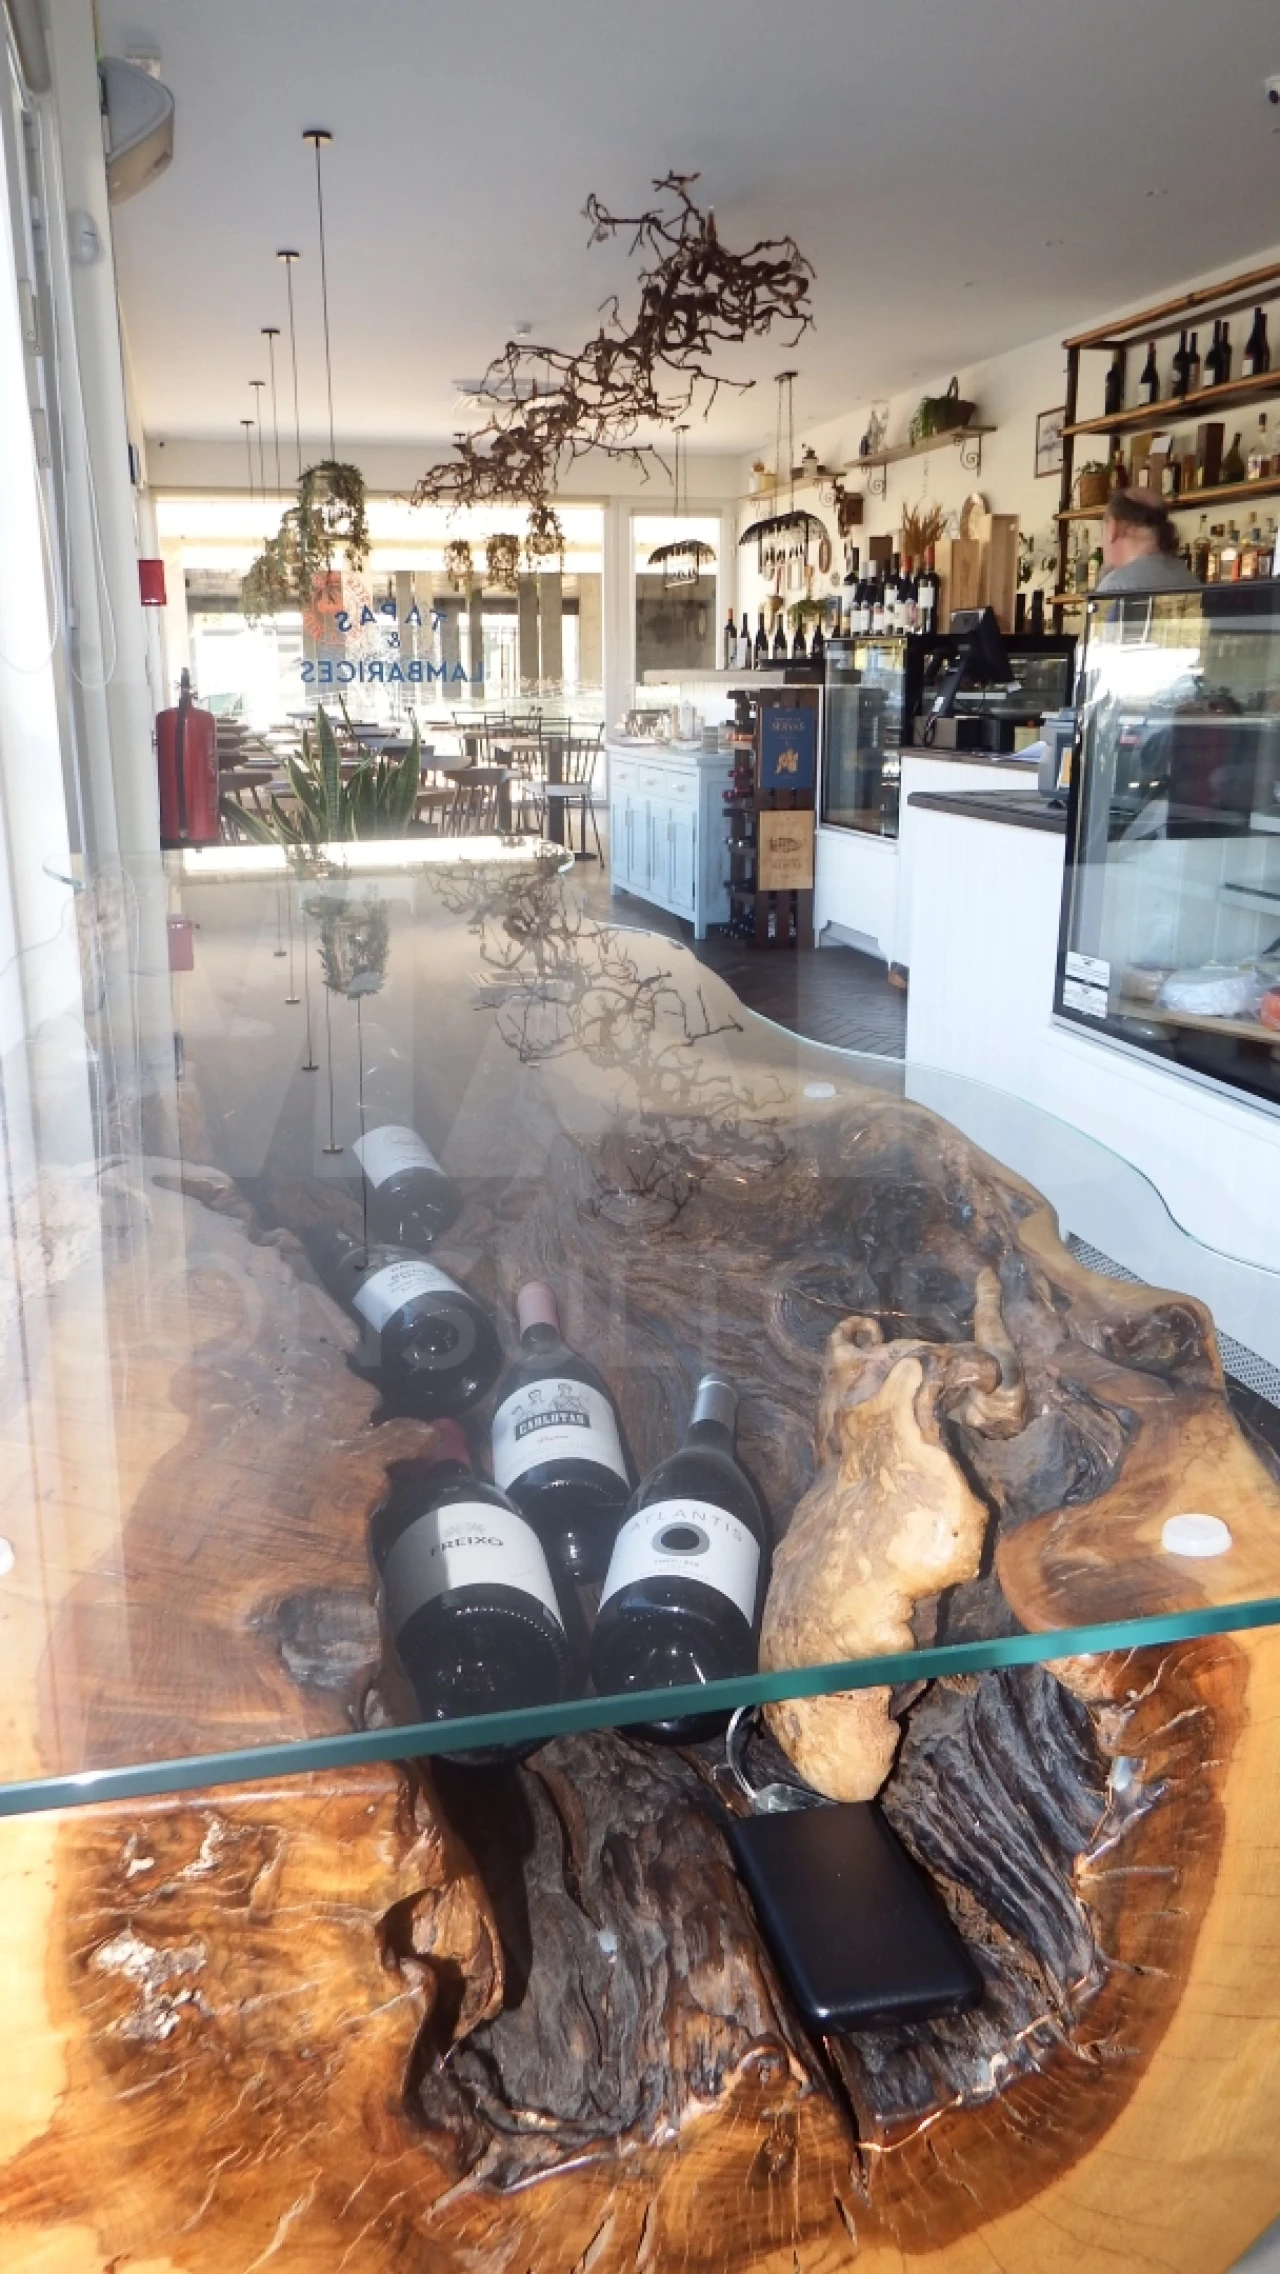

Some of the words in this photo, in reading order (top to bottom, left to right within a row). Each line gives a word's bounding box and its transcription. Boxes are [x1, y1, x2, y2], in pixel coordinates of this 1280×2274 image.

[518, 1412, 585, 1436] CARLOTAS
[629, 1509, 743, 1543] ATLANTIS
[430, 1536, 504, 1557] FREIXO
